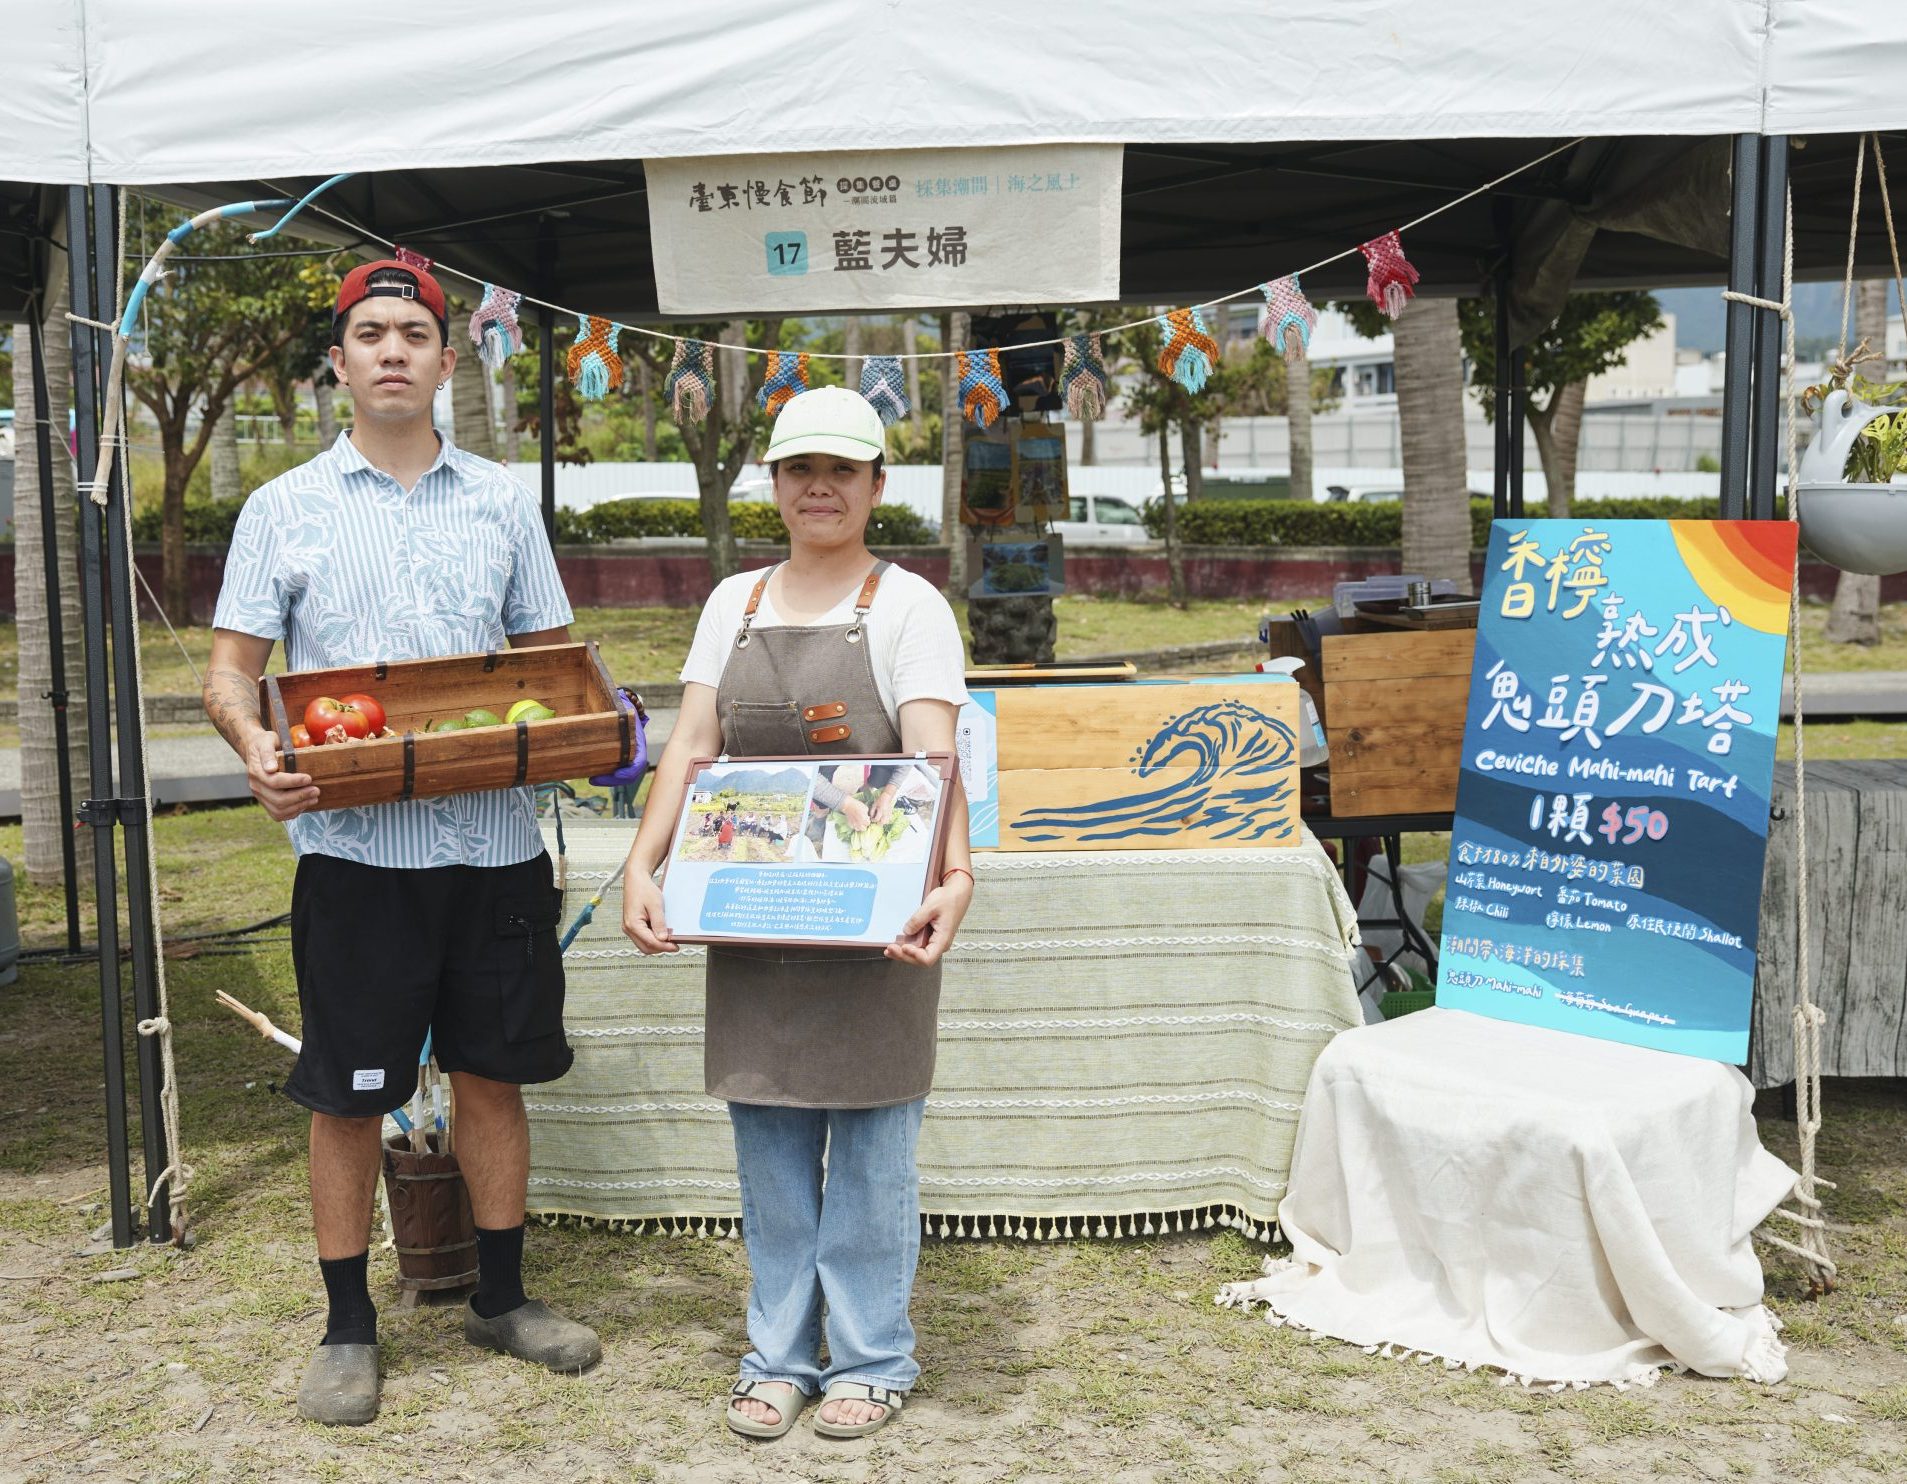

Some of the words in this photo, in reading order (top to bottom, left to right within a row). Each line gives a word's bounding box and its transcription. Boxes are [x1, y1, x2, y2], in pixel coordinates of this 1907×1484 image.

[690, 174, 827, 212] 臺東慢食節
[914, 175, 988, 198] 採集潮間
[1007, 172, 1081, 193] 海之風土
[773, 243, 801, 265] 17
[832, 226, 968, 271] 藍夫婦
[1501, 528, 1612, 619] 香檸
[1591, 591, 1732, 674] 熟成
[1481, 659, 1753, 755] 鬼頭刀塔
[1475, 750, 1559, 777] Ceviche
[1568, 756, 1675, 788] Mahi-mahi
[1688, 769, 1739, 799] Tart
[1598, 802, 1669, 845] $50
[1487, 876, 1543, 898] Honeywort
[1557, 886, 1580, 904] 番茄
[1584, 892, 1628, 912] Tomato
[1486, 903, 1509, 919] Chili
[1576, 916, 1612, 932] Lemon
[1698, 927, 1743, 949] Shallot
[1485, 977, 1543, 999] Mahi-mahi
